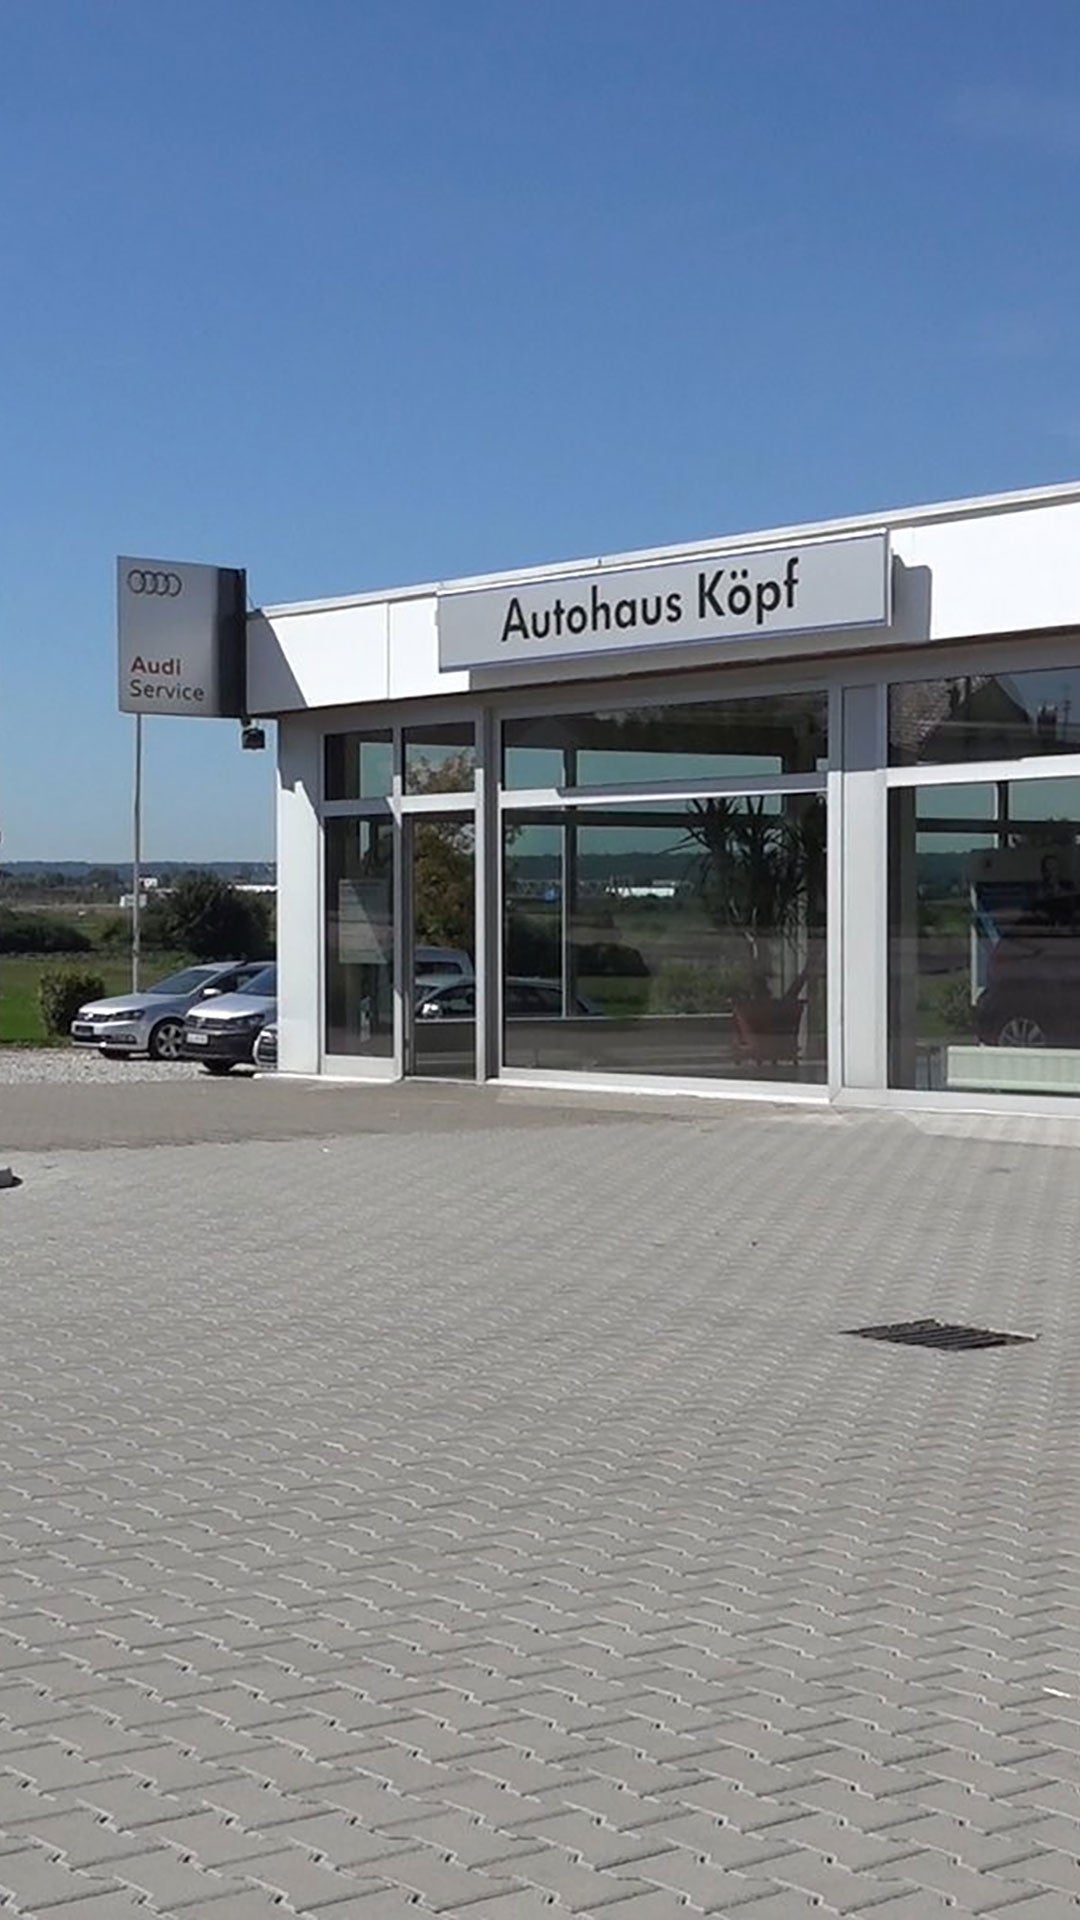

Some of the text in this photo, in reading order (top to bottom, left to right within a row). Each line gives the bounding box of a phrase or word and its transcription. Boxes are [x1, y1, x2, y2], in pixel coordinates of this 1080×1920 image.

[501, 557, 800, 642] Autohaus Köpf
[131, 655, 181, 676] Audi
[129, 679, 204, 701] Service
